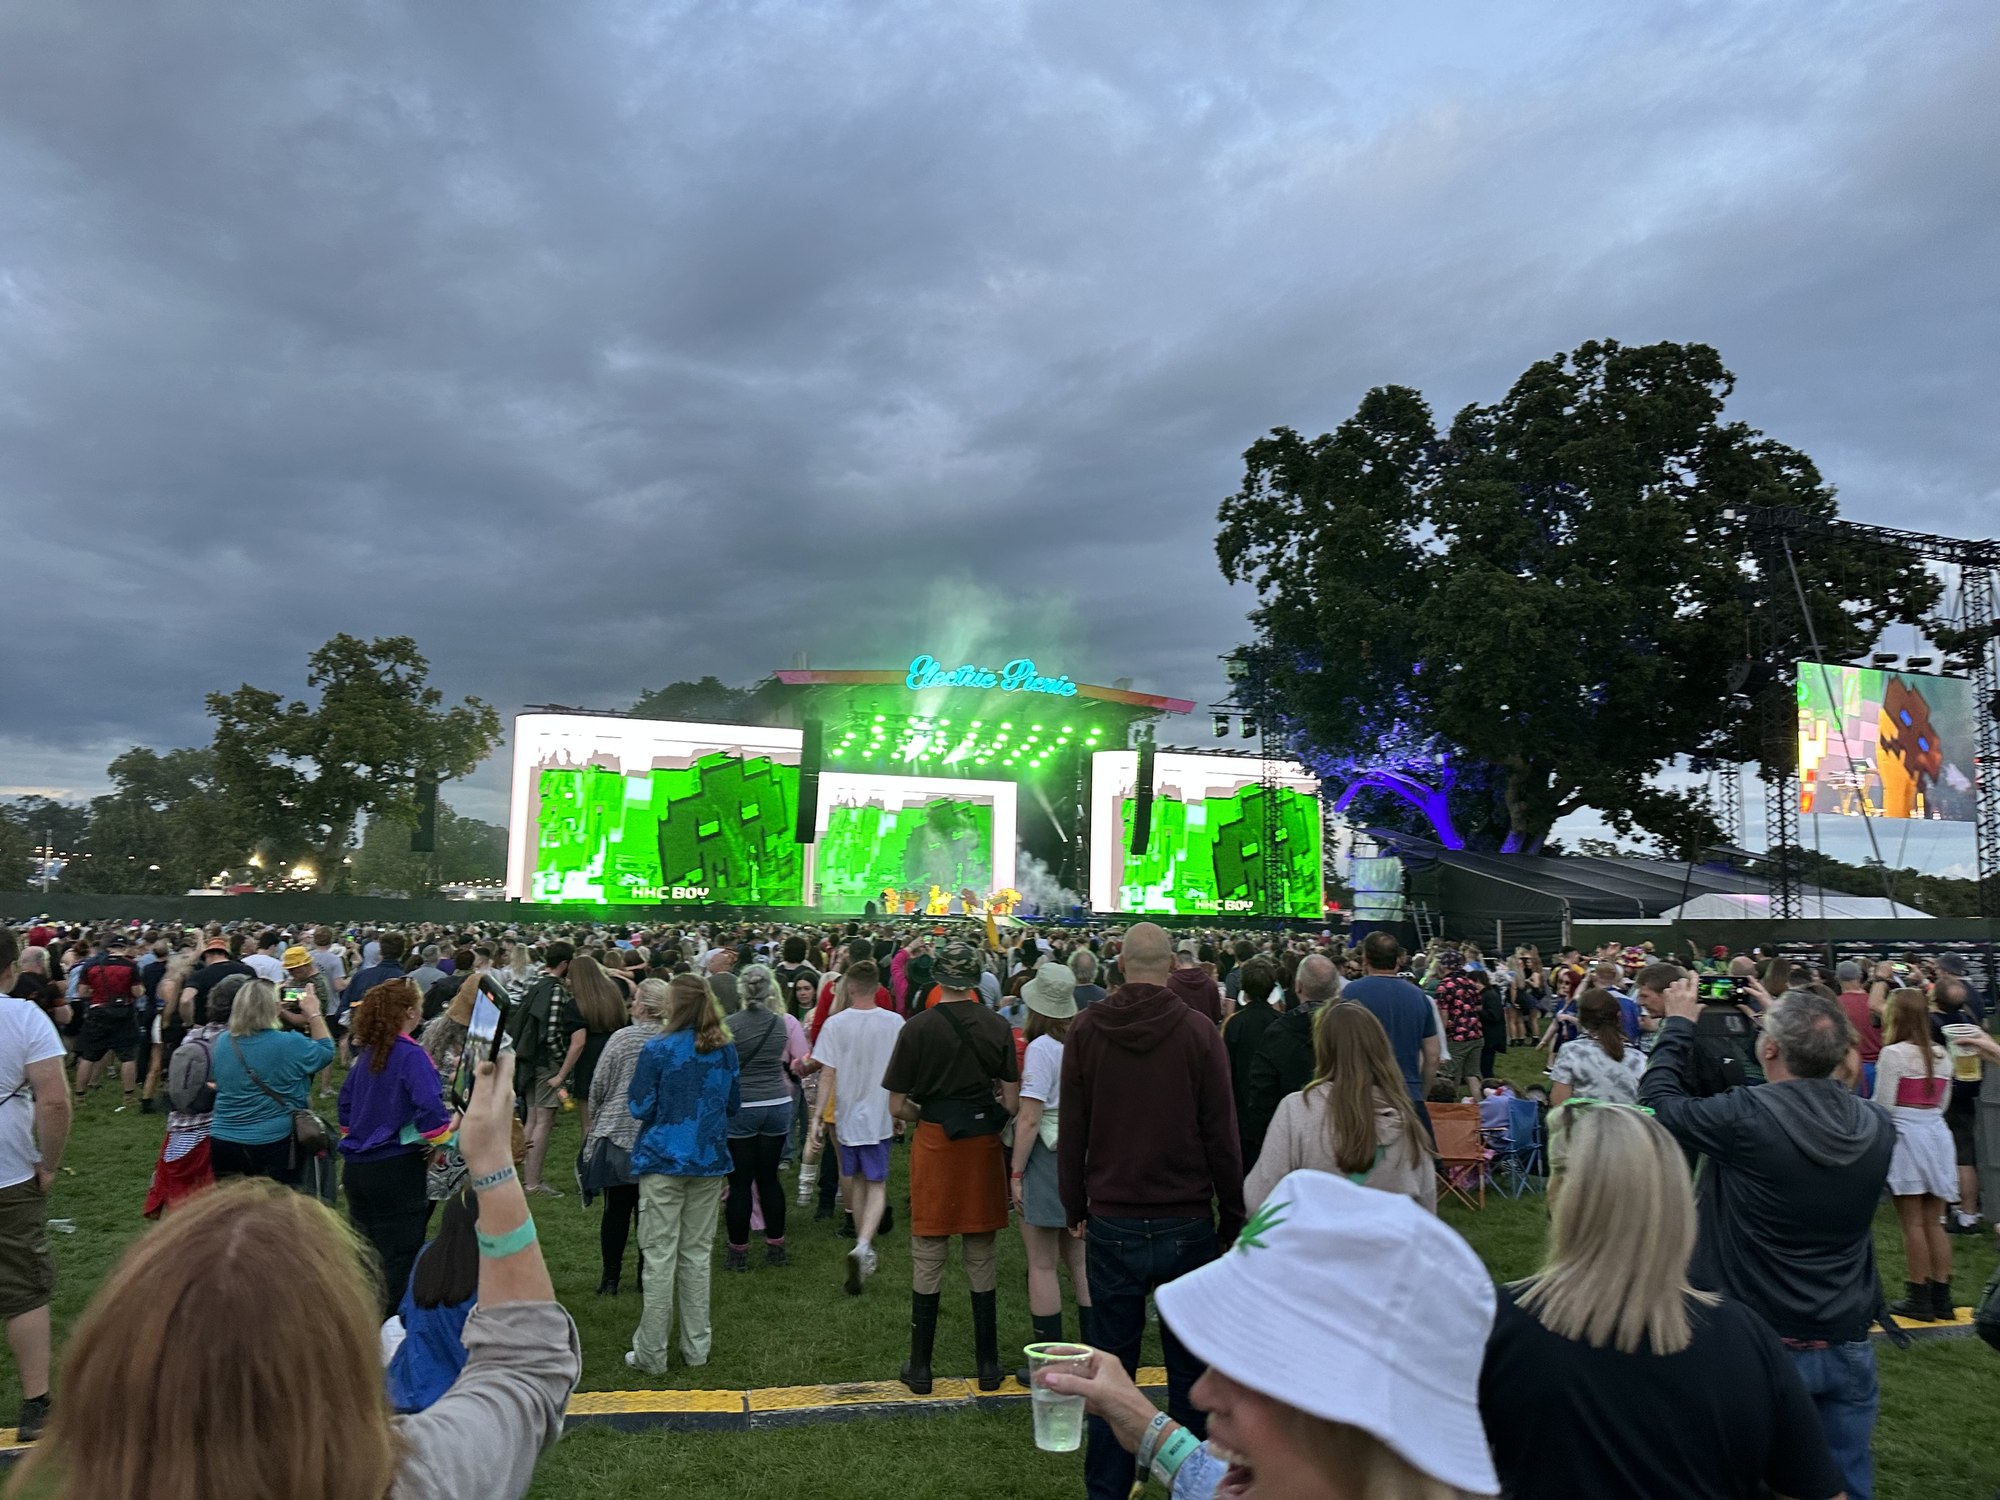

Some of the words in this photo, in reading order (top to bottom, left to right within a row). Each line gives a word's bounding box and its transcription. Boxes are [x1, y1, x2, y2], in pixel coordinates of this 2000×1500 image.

[906, 654, 998, 690] Electric
[1001, 658, 1077, 696] Picnic
[672, 887, 710, 899] BOY
[1224, 899, 1253, 911] BOY
